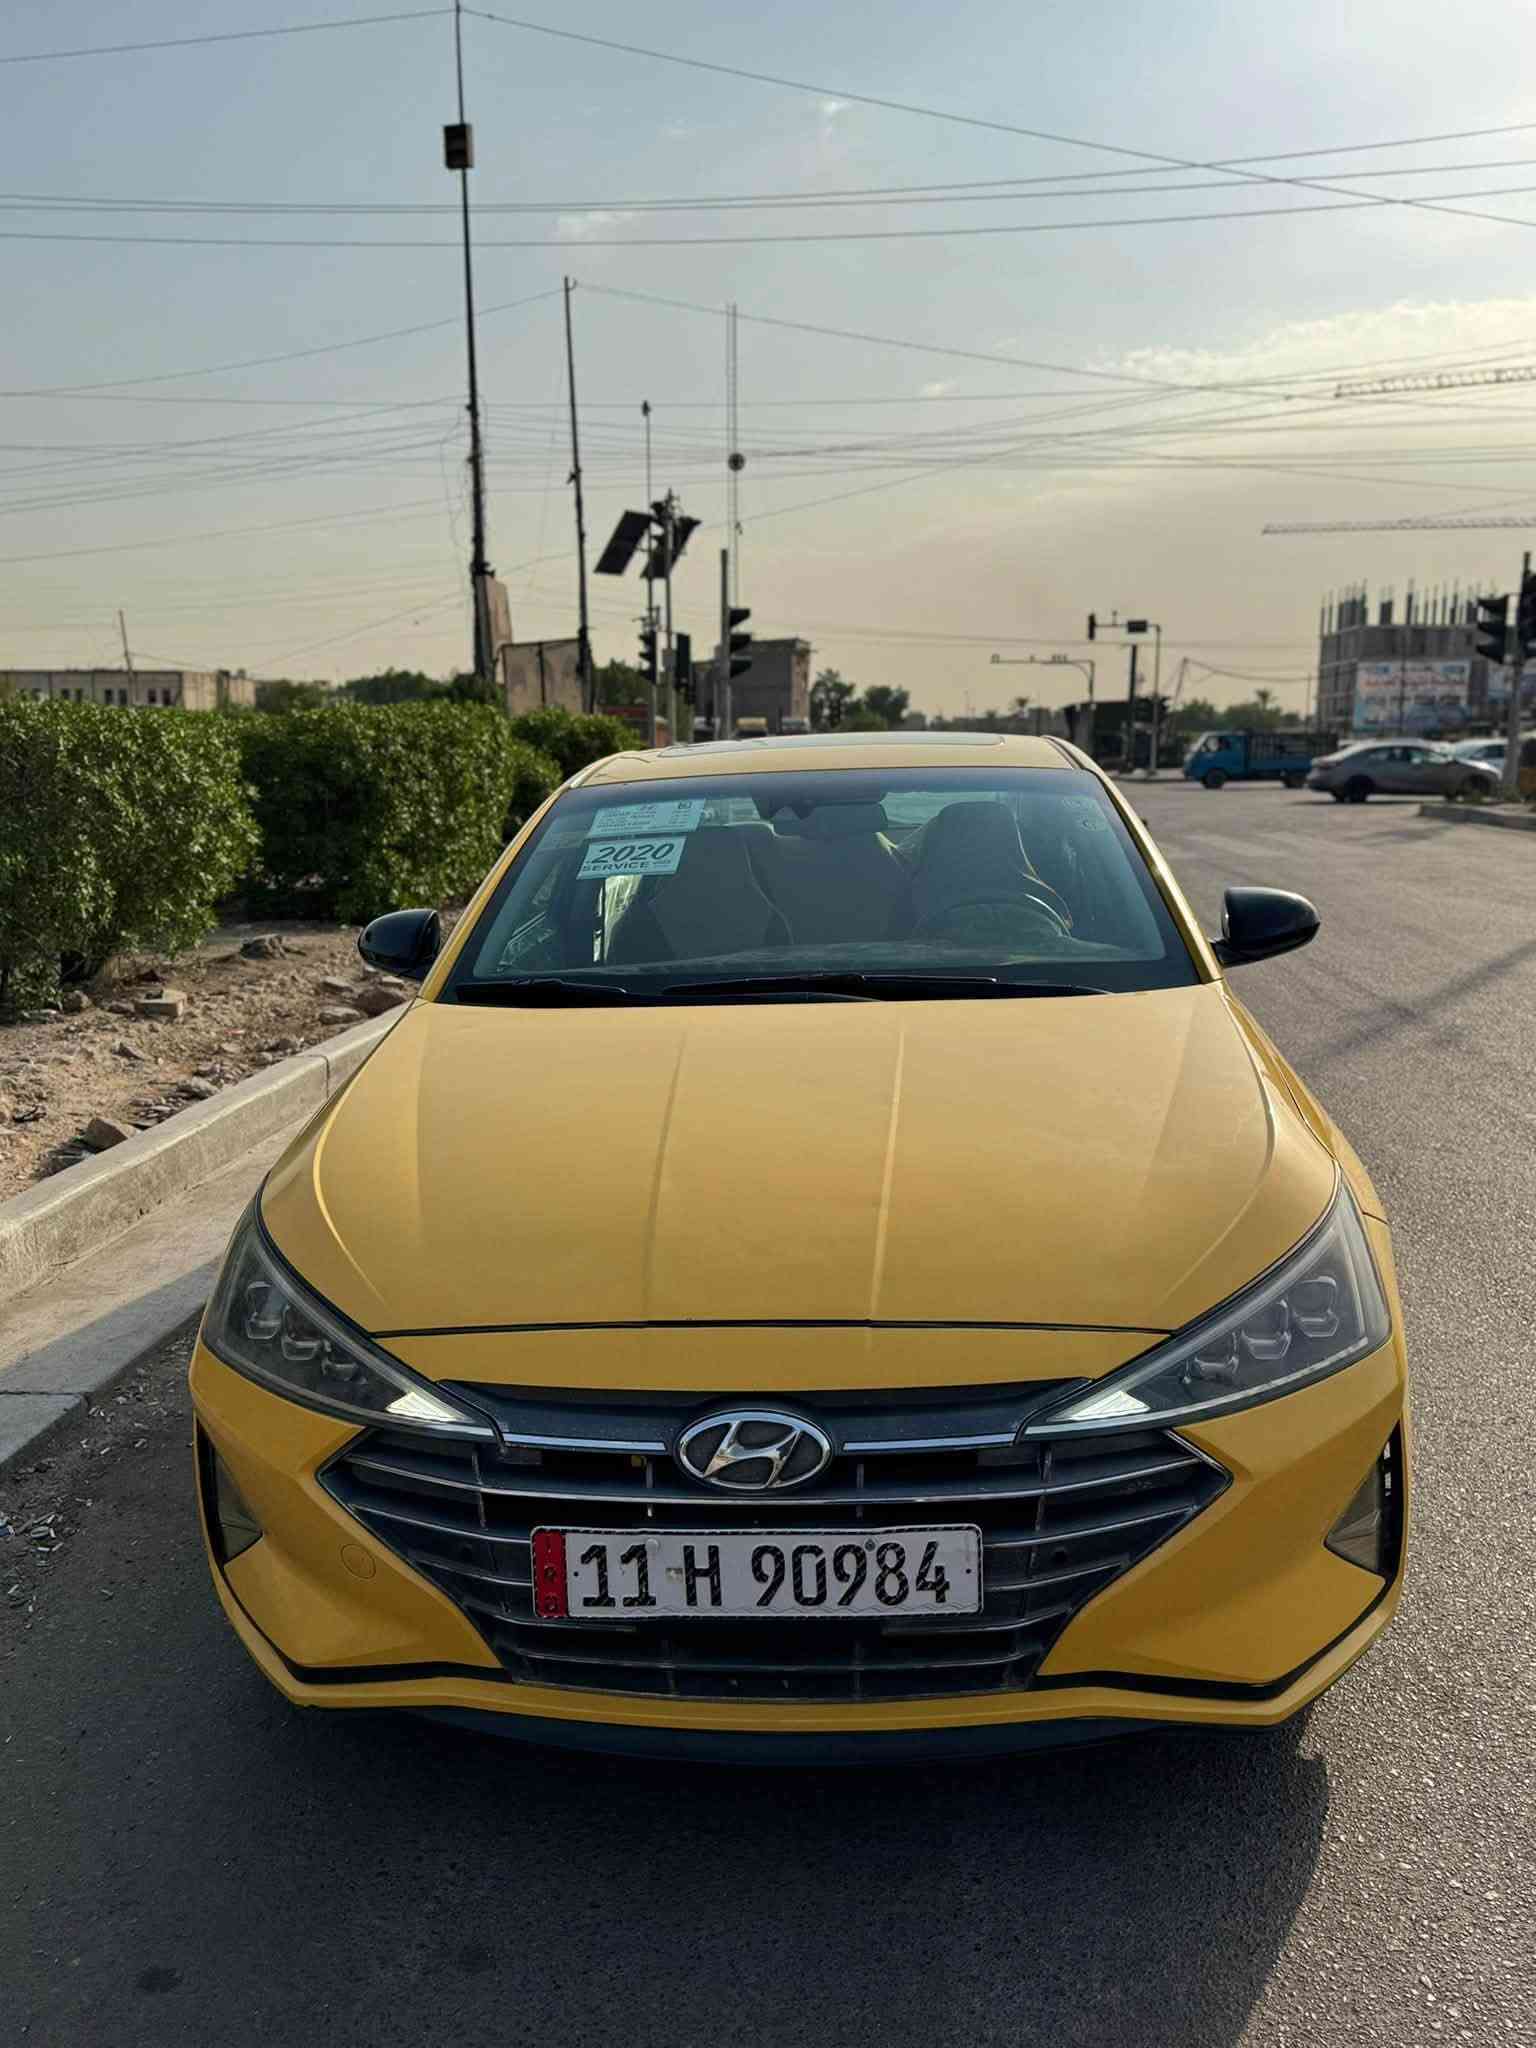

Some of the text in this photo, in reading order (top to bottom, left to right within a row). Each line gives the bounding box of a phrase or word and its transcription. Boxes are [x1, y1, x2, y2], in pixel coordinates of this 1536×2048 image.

[591, 843, 674, 863] 2020
[582, 861, 649, 872] SERVICE
[580, 1543, 657, 1608] 11
[682, 1544, 723, 1607] H
[750, 1540, 951, 1608] 90984
